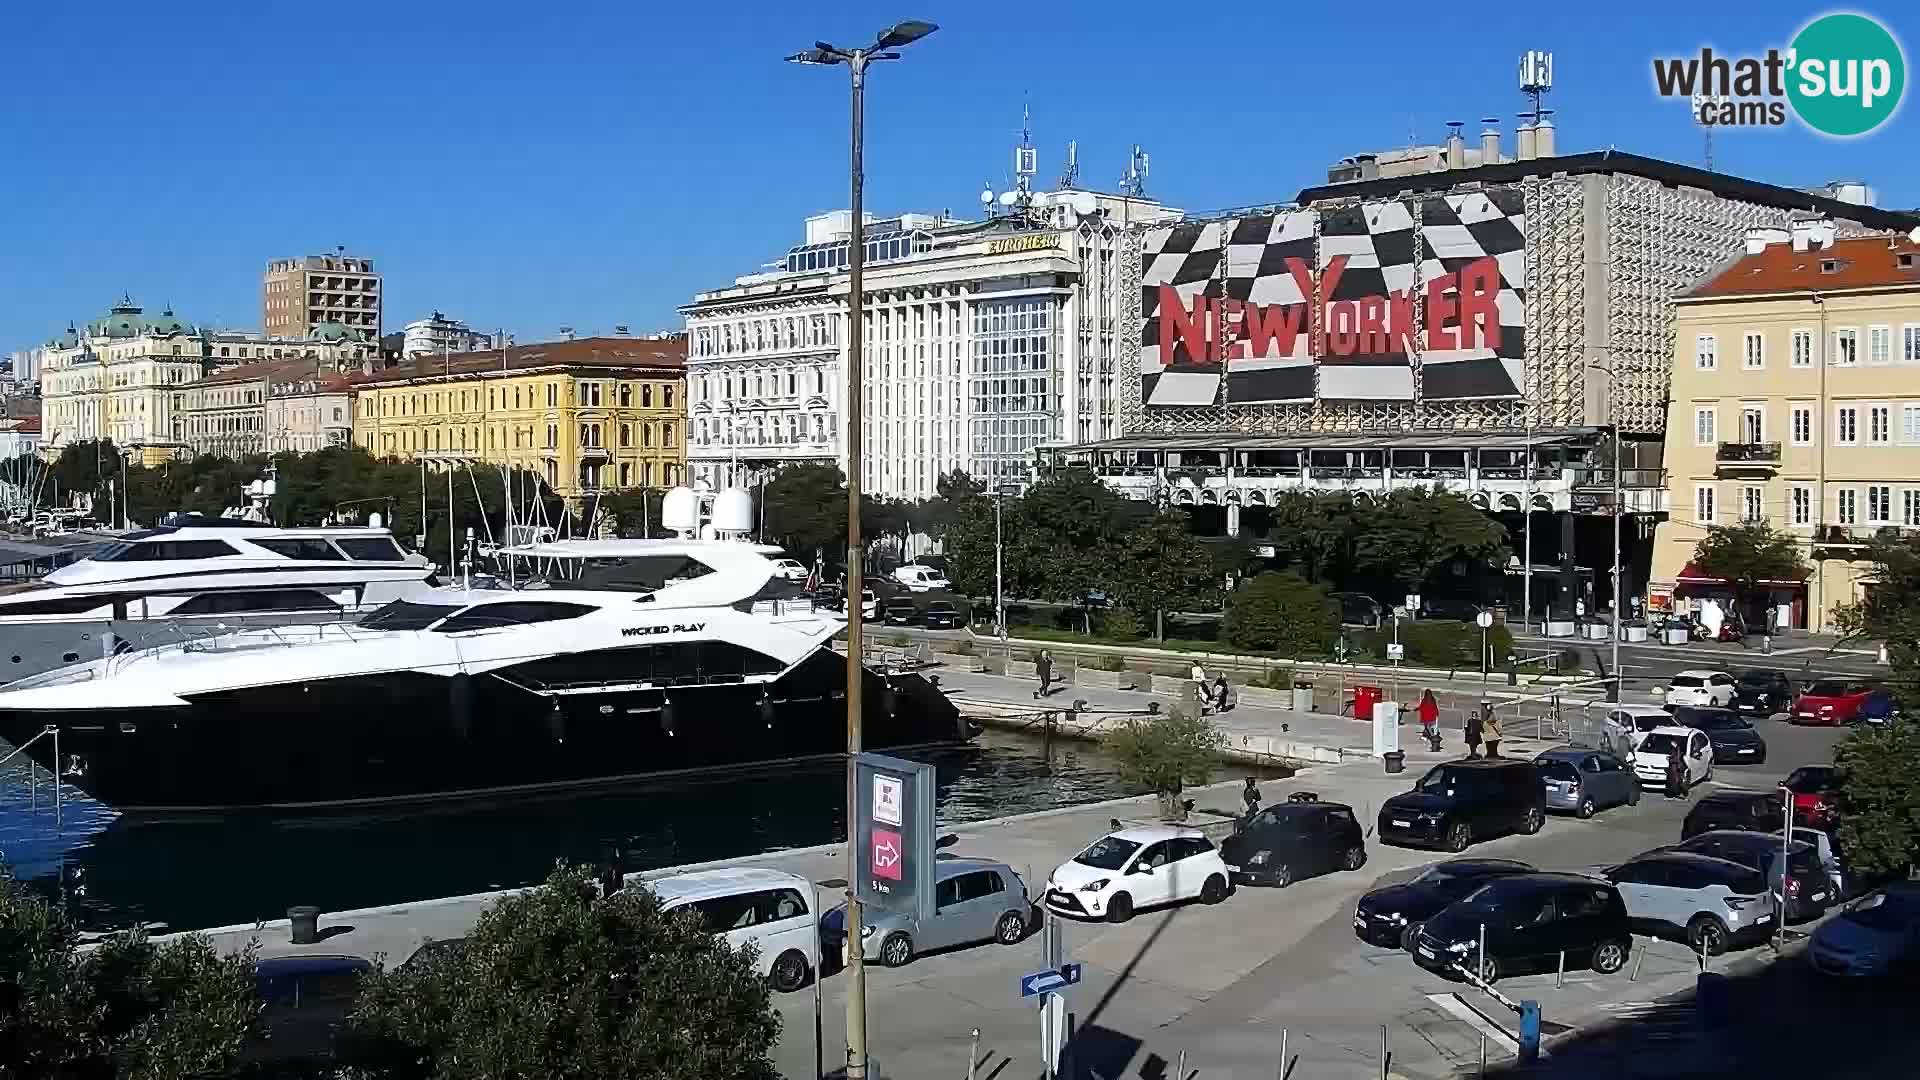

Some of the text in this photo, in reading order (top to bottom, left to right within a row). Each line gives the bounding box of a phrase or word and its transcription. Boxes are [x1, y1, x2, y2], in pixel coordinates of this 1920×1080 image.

[621, 623, 706, 637] WICKED PLAY
[878, 881, 890, 894] km
